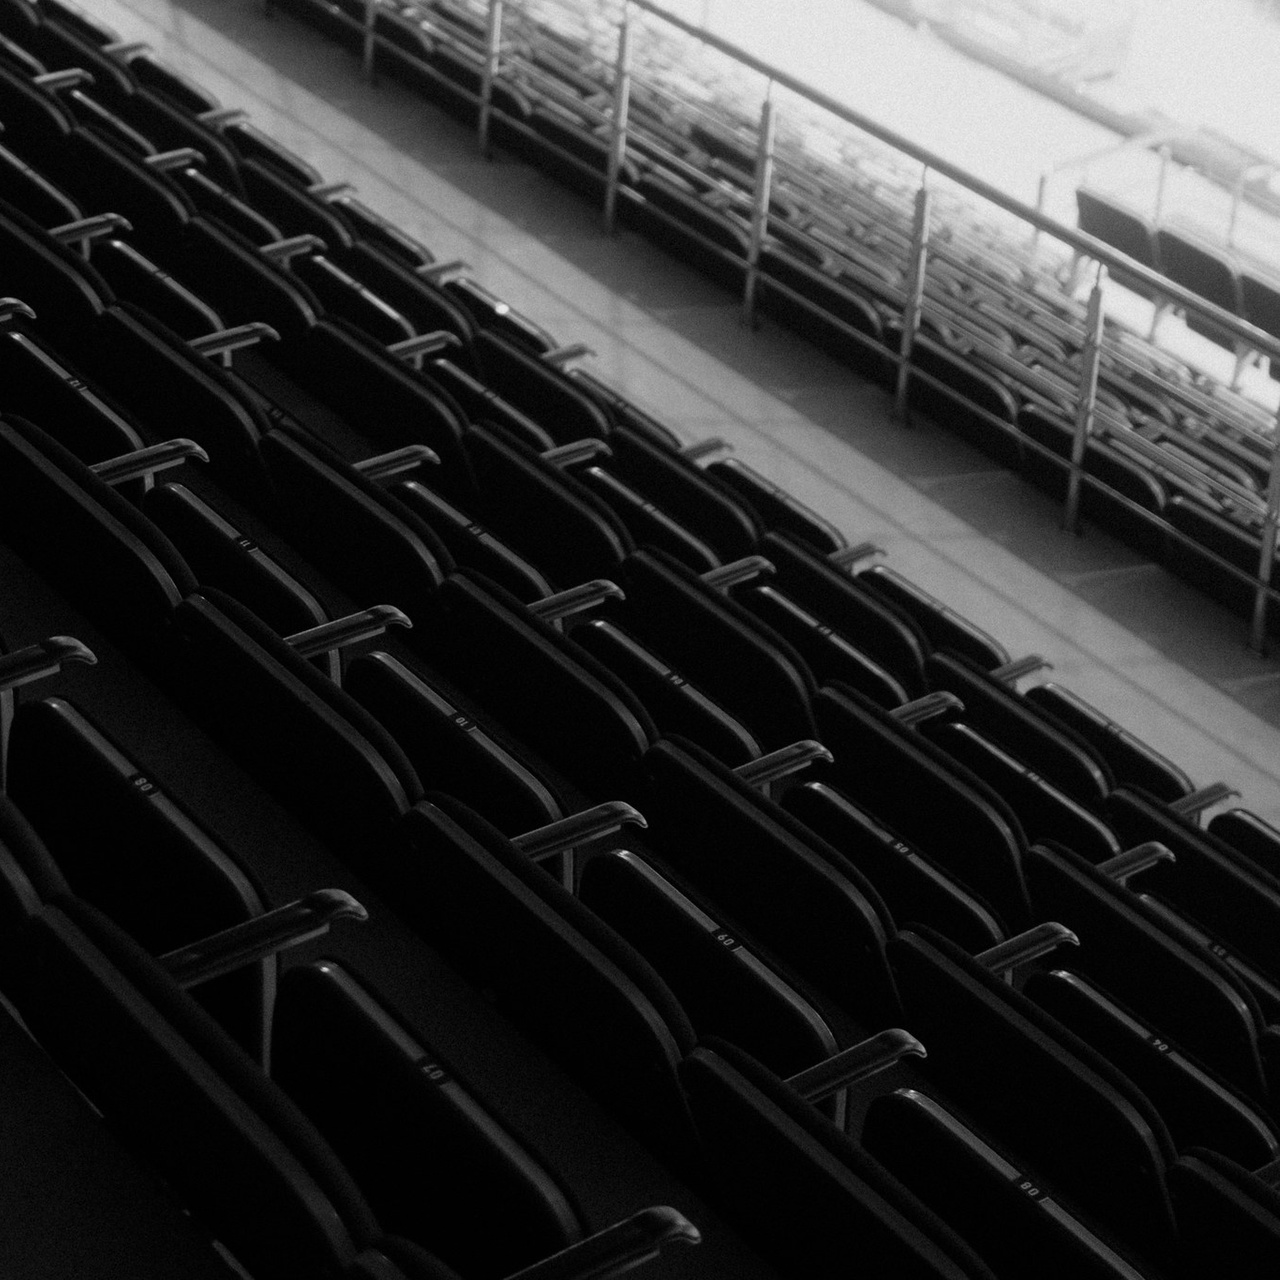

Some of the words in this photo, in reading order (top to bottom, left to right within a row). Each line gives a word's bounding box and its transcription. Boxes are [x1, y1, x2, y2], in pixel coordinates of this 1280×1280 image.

[455, 717, 469, 727] 10
[134, 777, 153, 791] 08
[717, 934, 735, 946] 09
[421, 1064, 444, 1080] 07
[1020, 1181, 1040, 1196] 08
